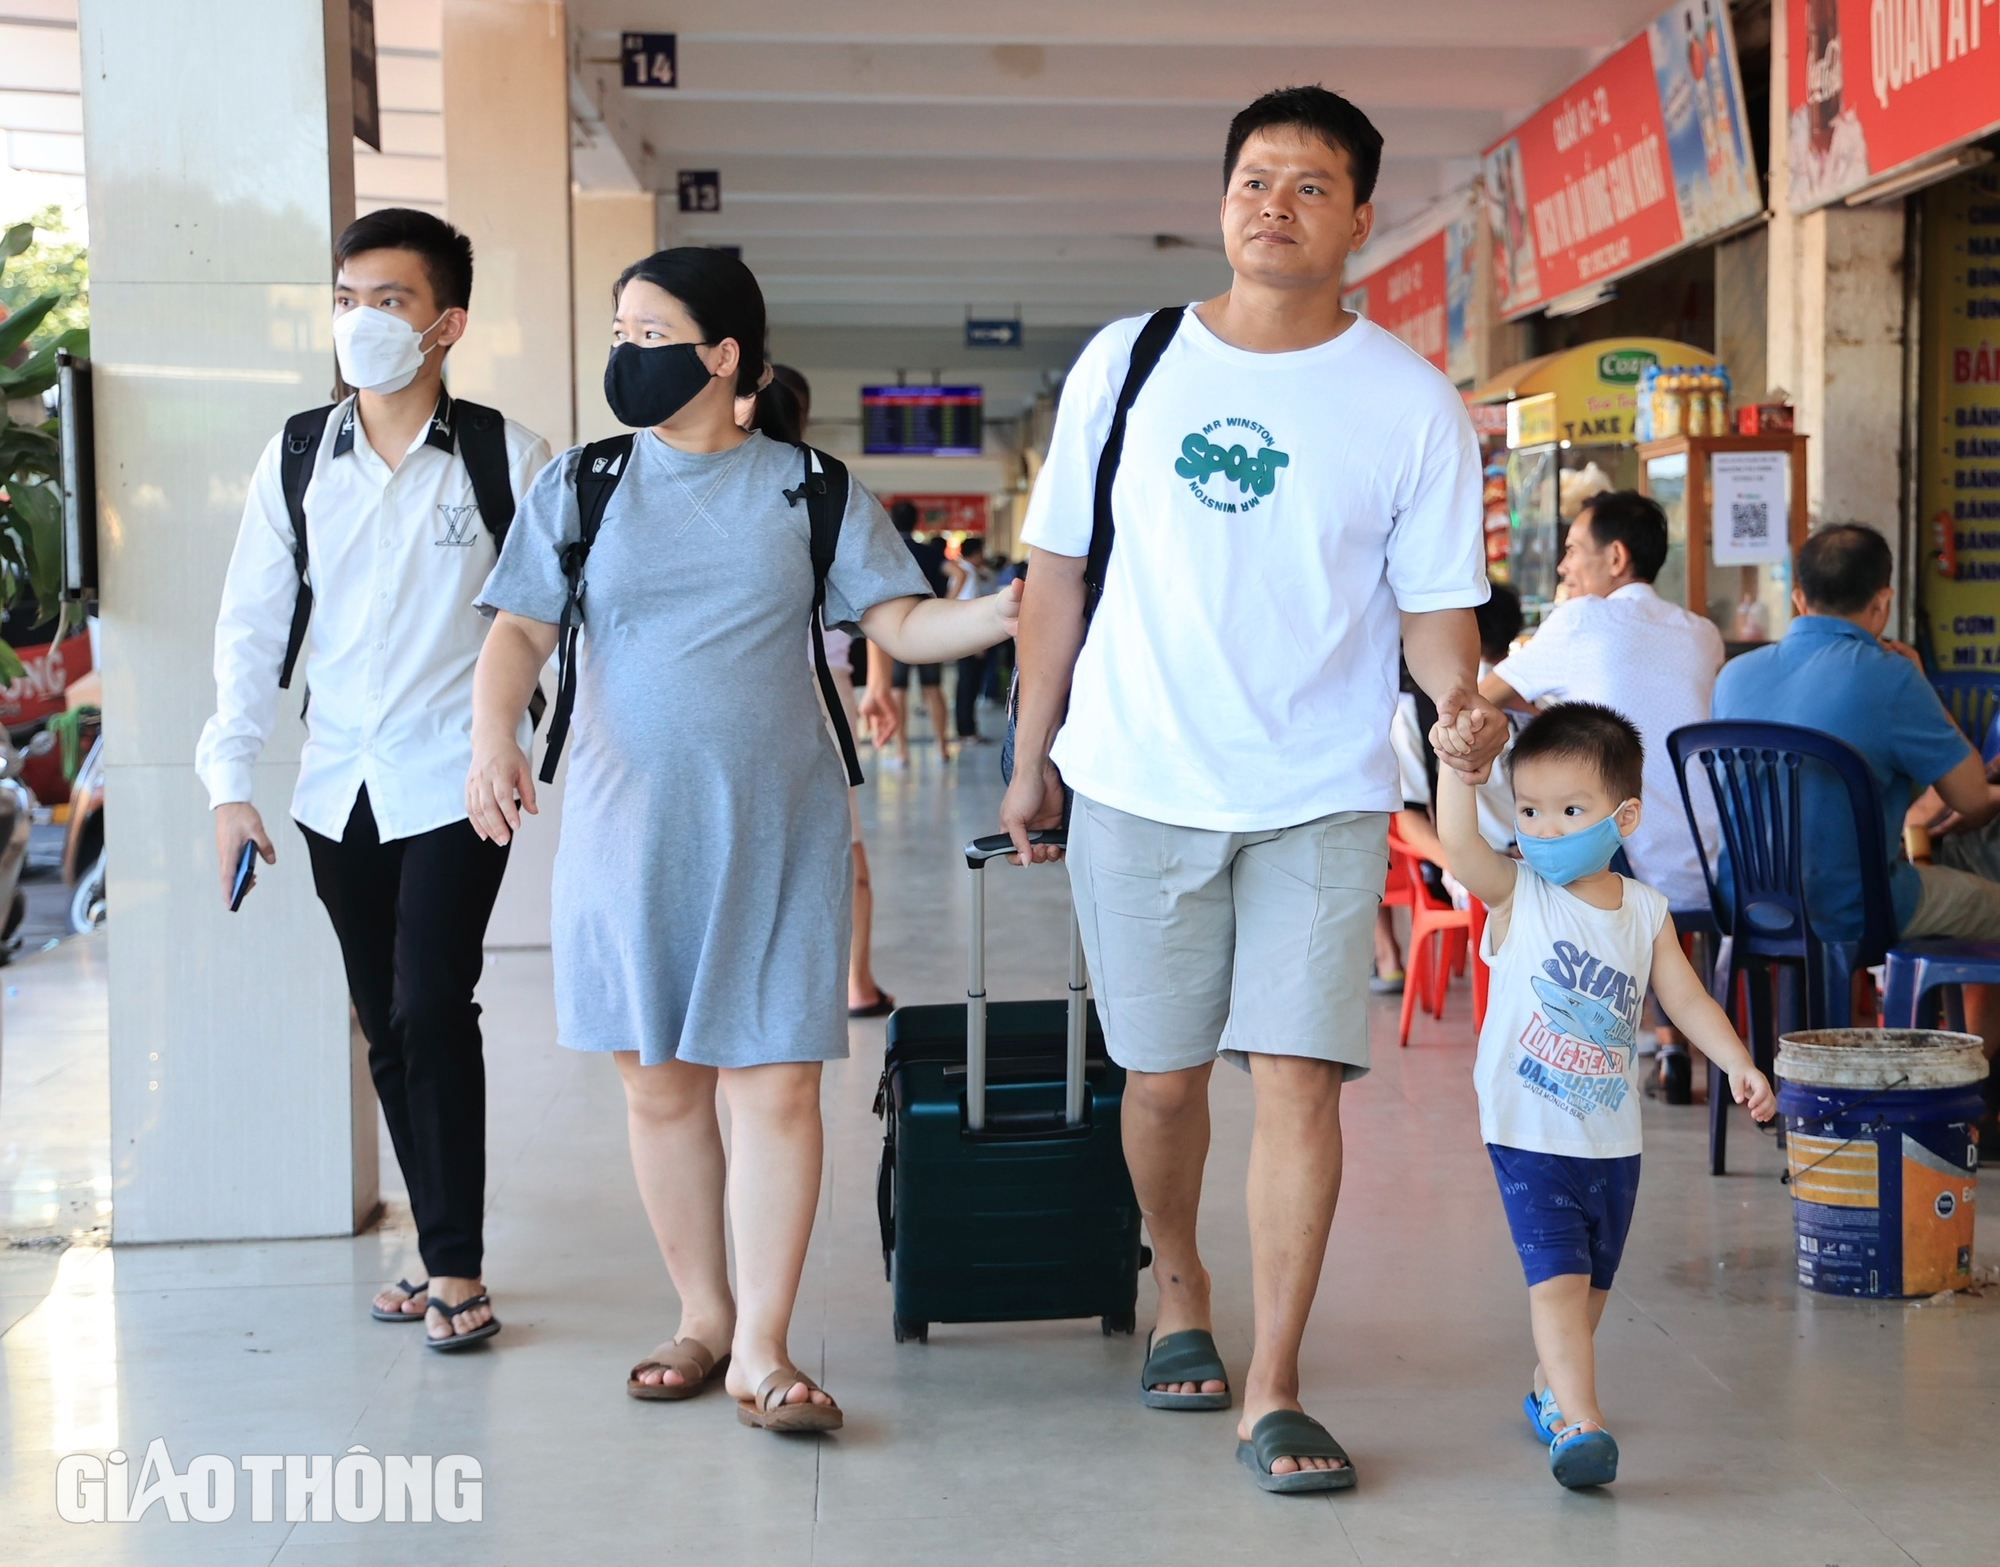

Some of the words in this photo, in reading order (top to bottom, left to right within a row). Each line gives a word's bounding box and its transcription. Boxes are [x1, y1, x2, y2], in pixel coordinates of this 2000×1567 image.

[632, 52, 673, 84] 14
[687, 185, 716, 210] 13
[1202, 420, 1222, 436] MR
[1226, 418, 1275, 447] WINSTON
[1563, 418, 1621, 439] TAKE
[1175, 433, 1289, 497] SPORT
[1189, 481, 1237, 513] WINSTON
[1240, 496, 1260, 513] MR
[1522, 1017, 1578, 1071] LONG
[1519, 1057, 1559, 1096] UALA
[1523, 1080, 1543, 1097] SANTA
[1543, 1092, 1569, 1113] MONICA
[1569, 1108, 1586, 1122] BEACH
